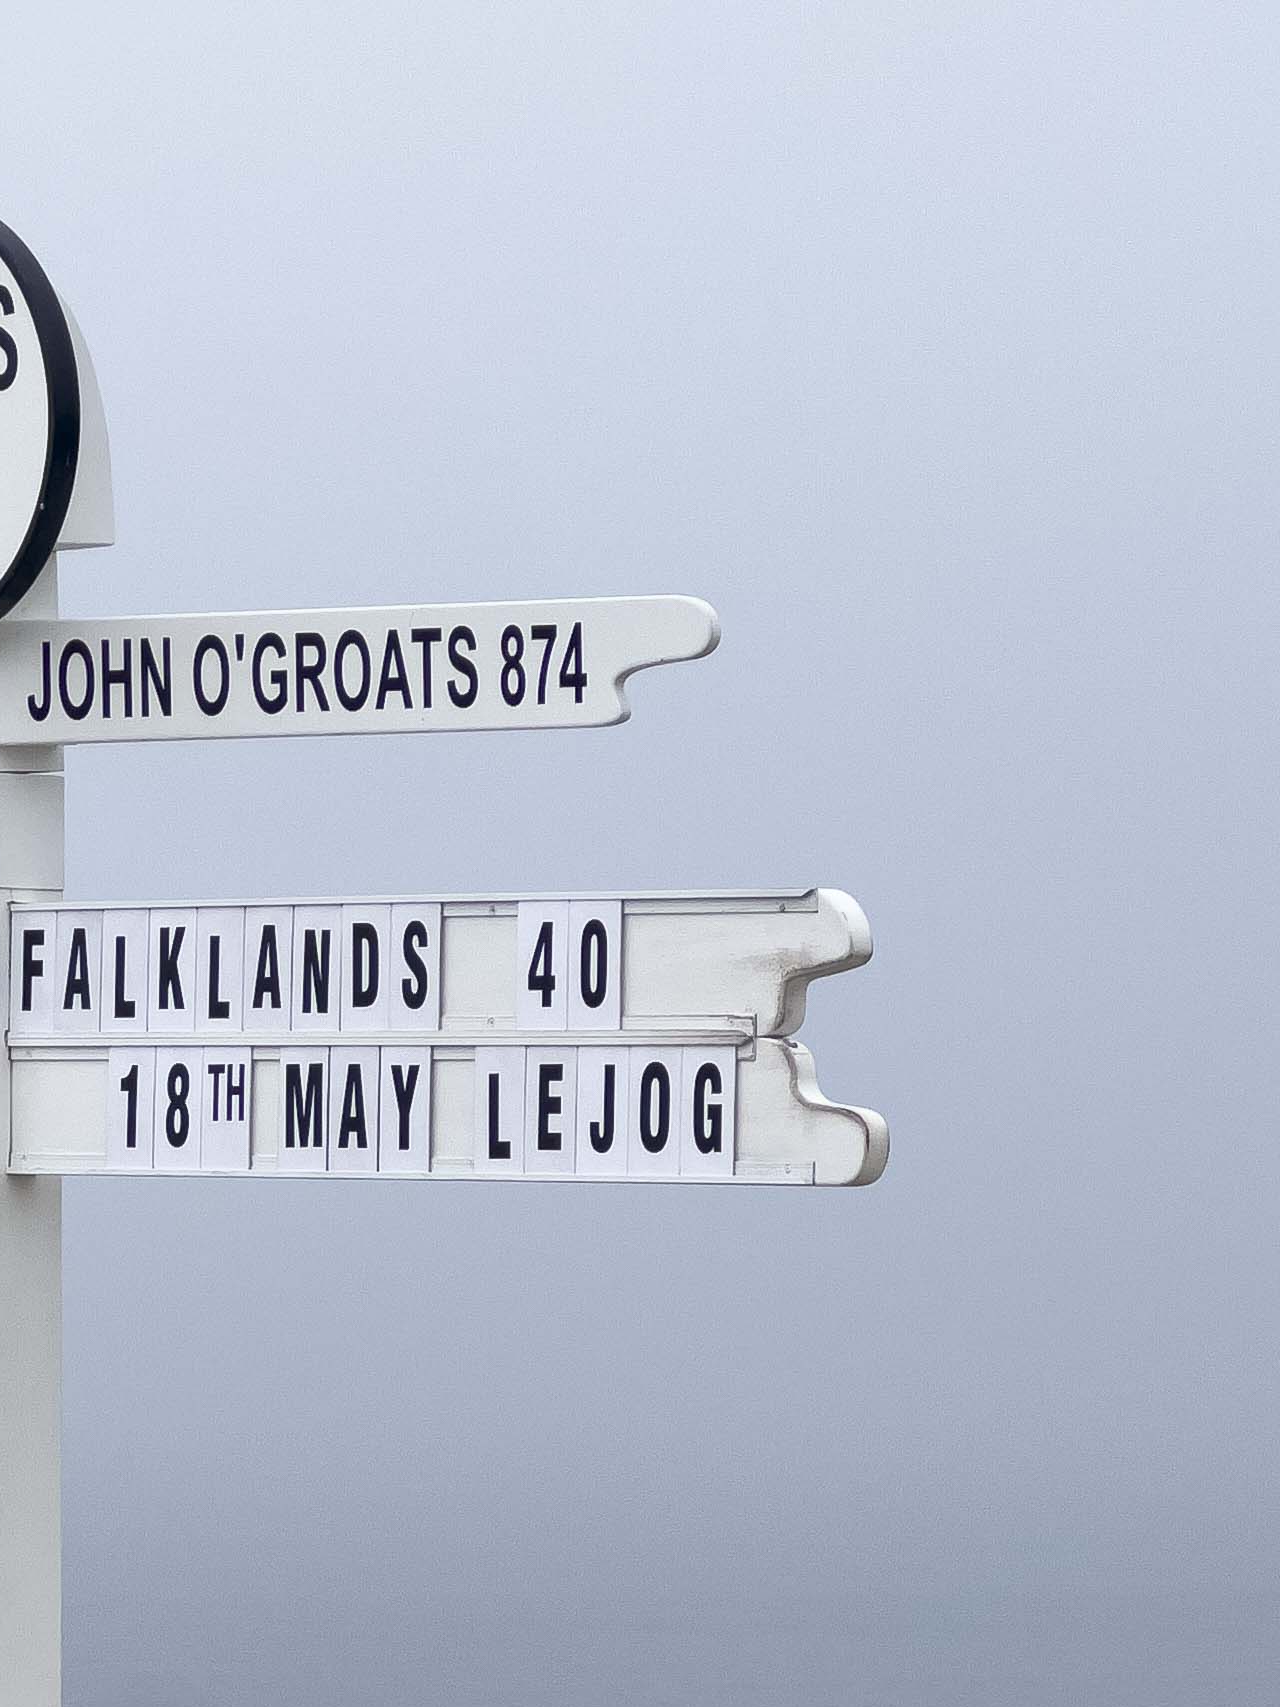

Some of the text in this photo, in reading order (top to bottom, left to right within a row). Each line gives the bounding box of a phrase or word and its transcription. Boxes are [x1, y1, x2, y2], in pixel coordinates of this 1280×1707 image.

[27, 621, 588, 722] JOHN O'GROATS 874
[21, 919, 608, 1019] FALKLANDS 40
[285, 1063, 420, 1148] MAY
[488, 1061, 723, 1160] LEJOG
